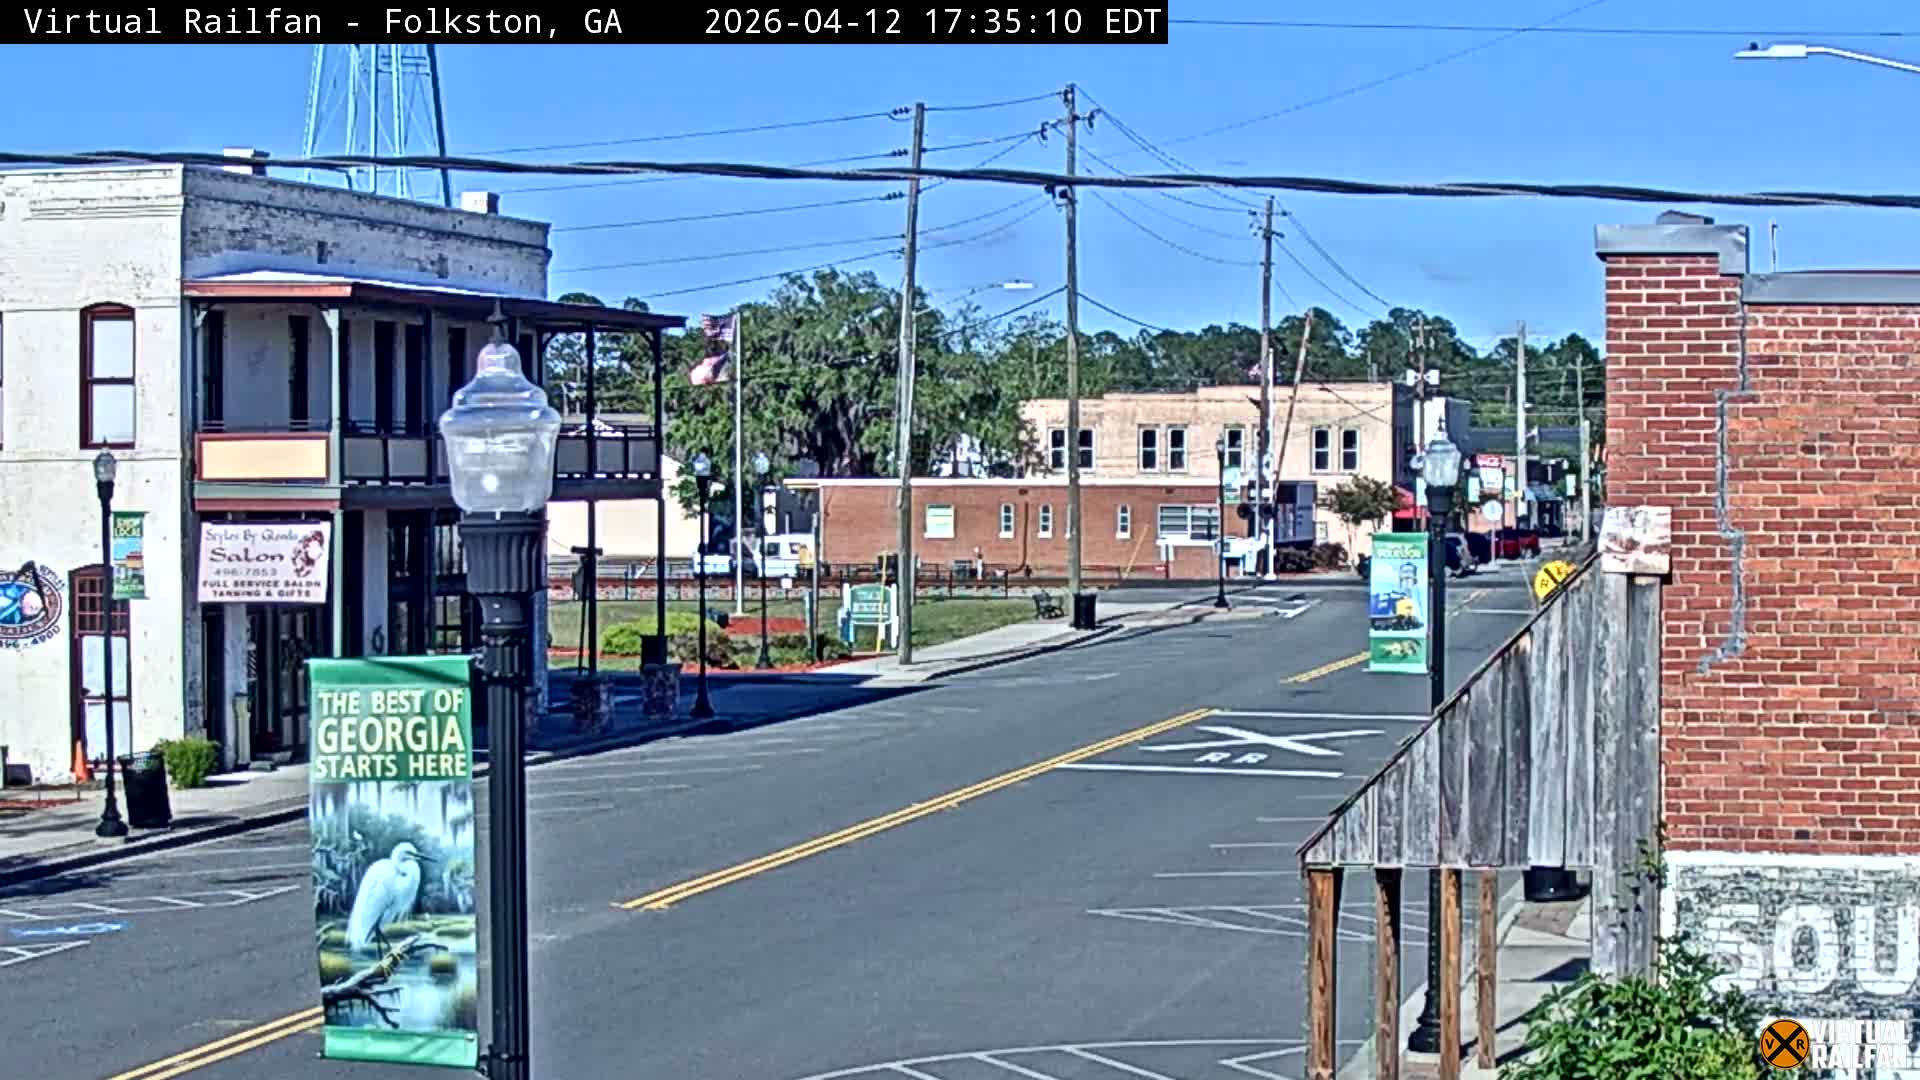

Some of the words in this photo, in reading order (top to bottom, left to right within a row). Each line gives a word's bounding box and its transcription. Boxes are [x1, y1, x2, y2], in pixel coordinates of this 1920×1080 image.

[209, 547, 285, 563] Salon
[203, 580, 228, 588] FULL
[233, 580, 280, 588] SERVICE
[284, 580, 321, 588] SALON
[212, 589, 261, 598] TANNING
[278, 589, 312, 598] GIFTS
[318, 691, 361, 715] THE
[371, 690, 425, 714] BEST
[434, 689, 465, 713] OF
[317, 715, 466, 754] GEORGIA
[314, 754, 398, 779] STARTS
[408, 754, 467, 777] HERE
